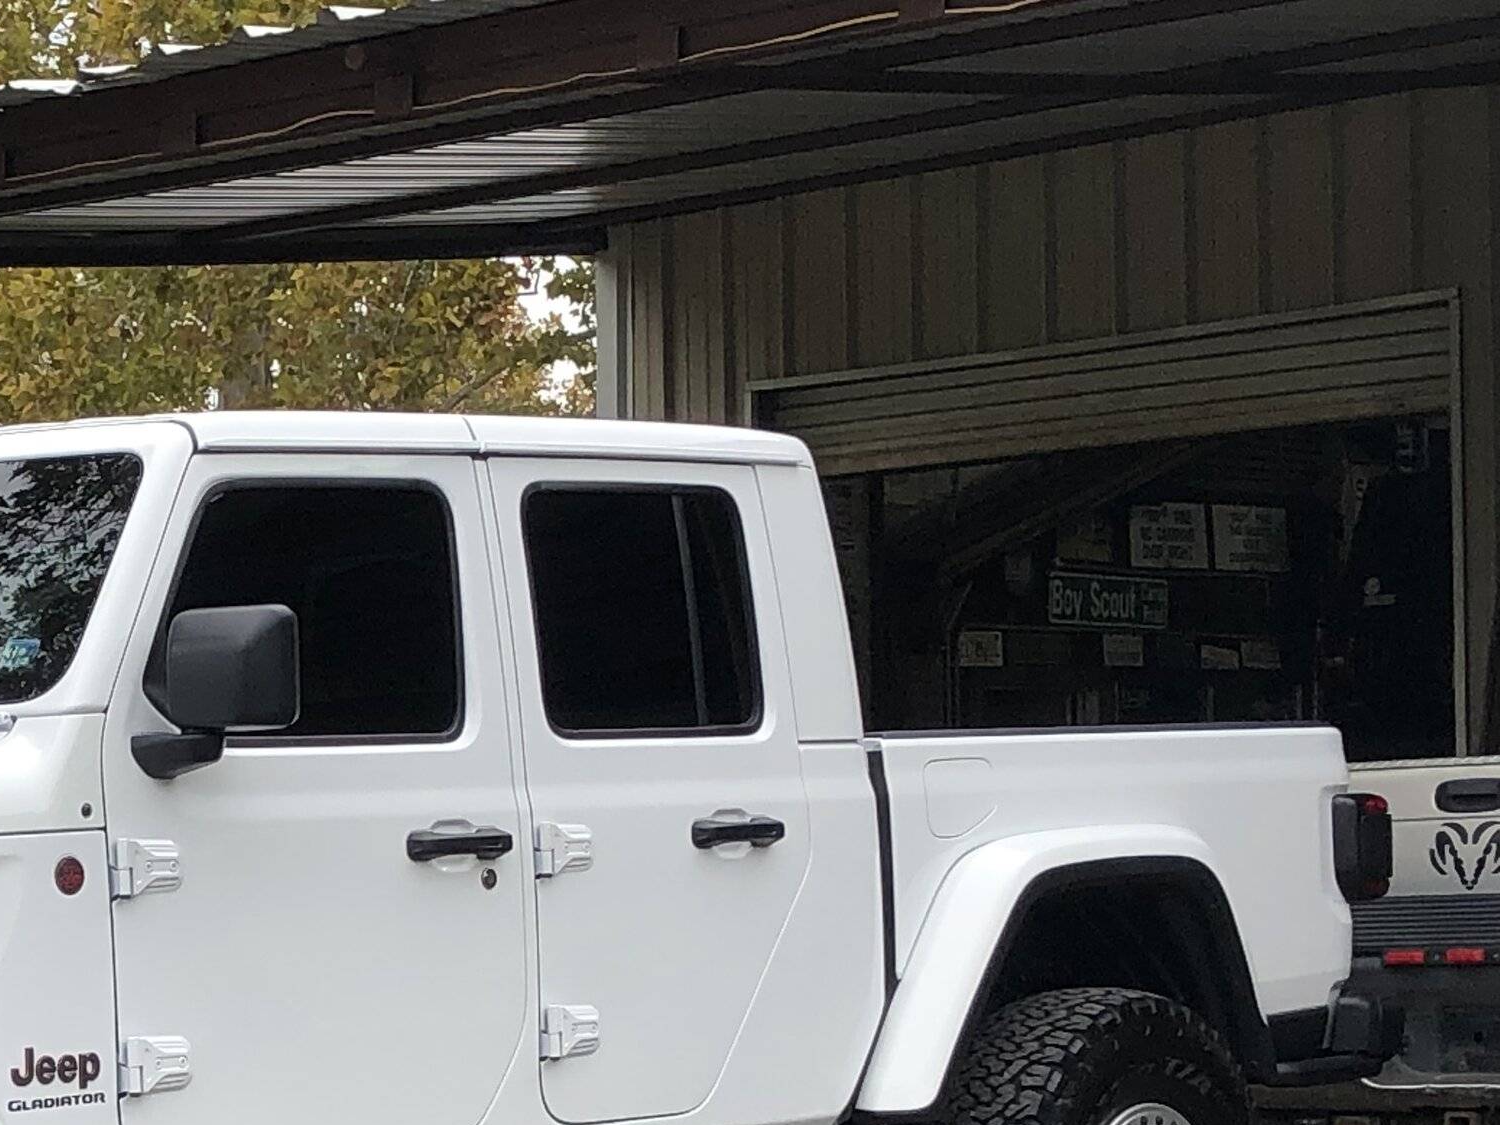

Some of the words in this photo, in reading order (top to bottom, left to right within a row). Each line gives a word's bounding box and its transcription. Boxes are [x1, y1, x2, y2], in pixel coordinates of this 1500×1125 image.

[1051, 578, 1083, 621] Boy
[1090, 580, 1137, 618] Scout
[10, 1047, 101, 1090] Jeep
[7, 1092, 106, 1112] GLADIATOR
